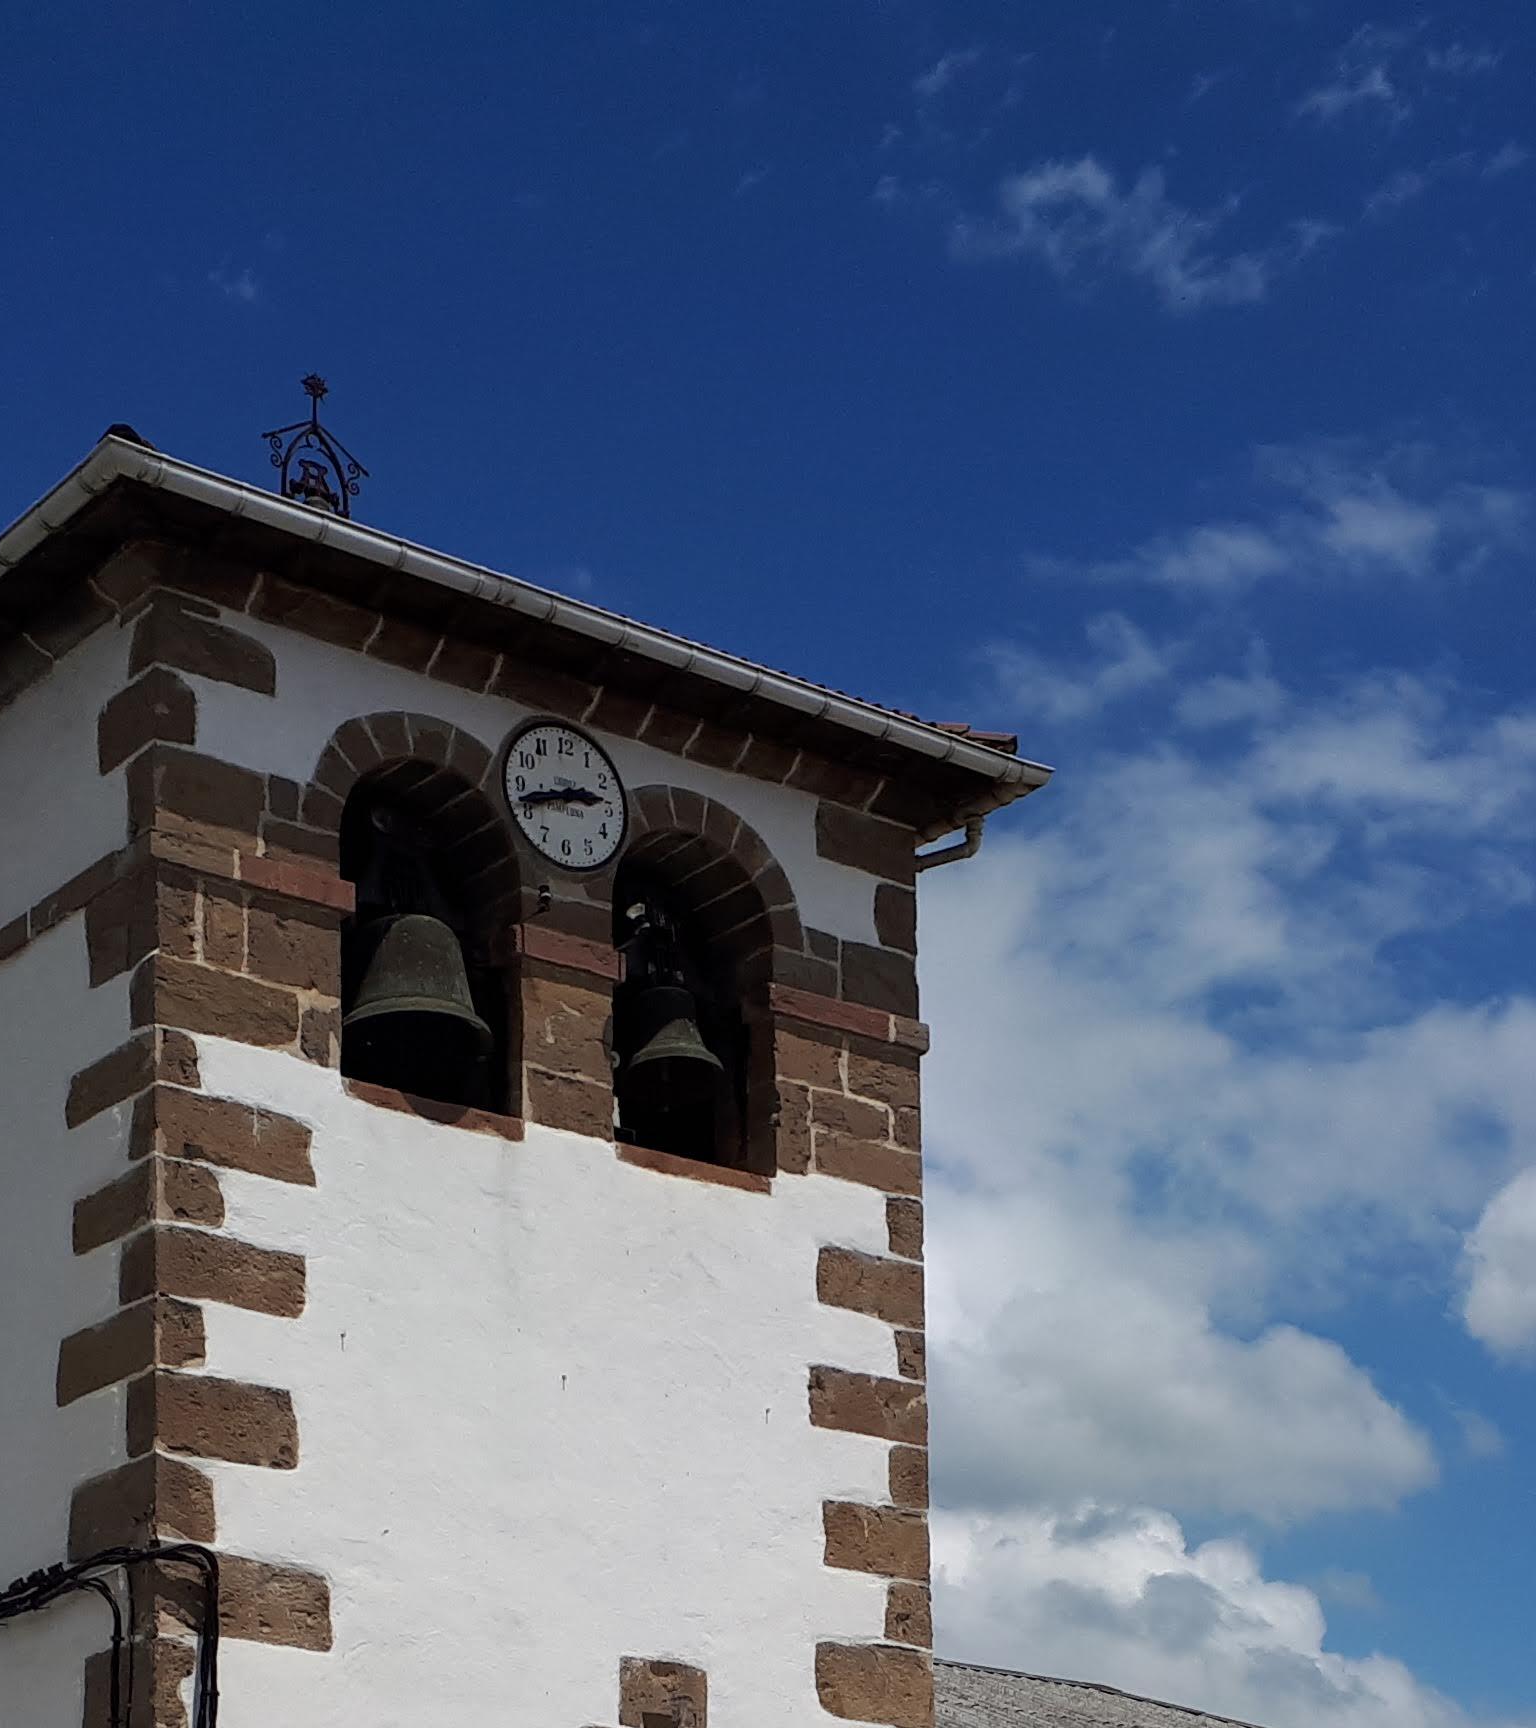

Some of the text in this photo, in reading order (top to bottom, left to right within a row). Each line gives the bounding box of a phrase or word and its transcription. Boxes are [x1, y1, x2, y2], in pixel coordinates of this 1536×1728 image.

[536, 738, 547, 757] 11
[558, 737, 574, 756] 12
[519, 751, 535, 769] 10
[583, 752, 590, 768] 1
[515, 775, 525, 792] 9
[598, 773, 608, 790] 2
[540, 825, 550, 843] 7
[599, 823, 608, 839] 4
[562, 839, 571, 856] 6
[584, 838, 593, 856] 5
